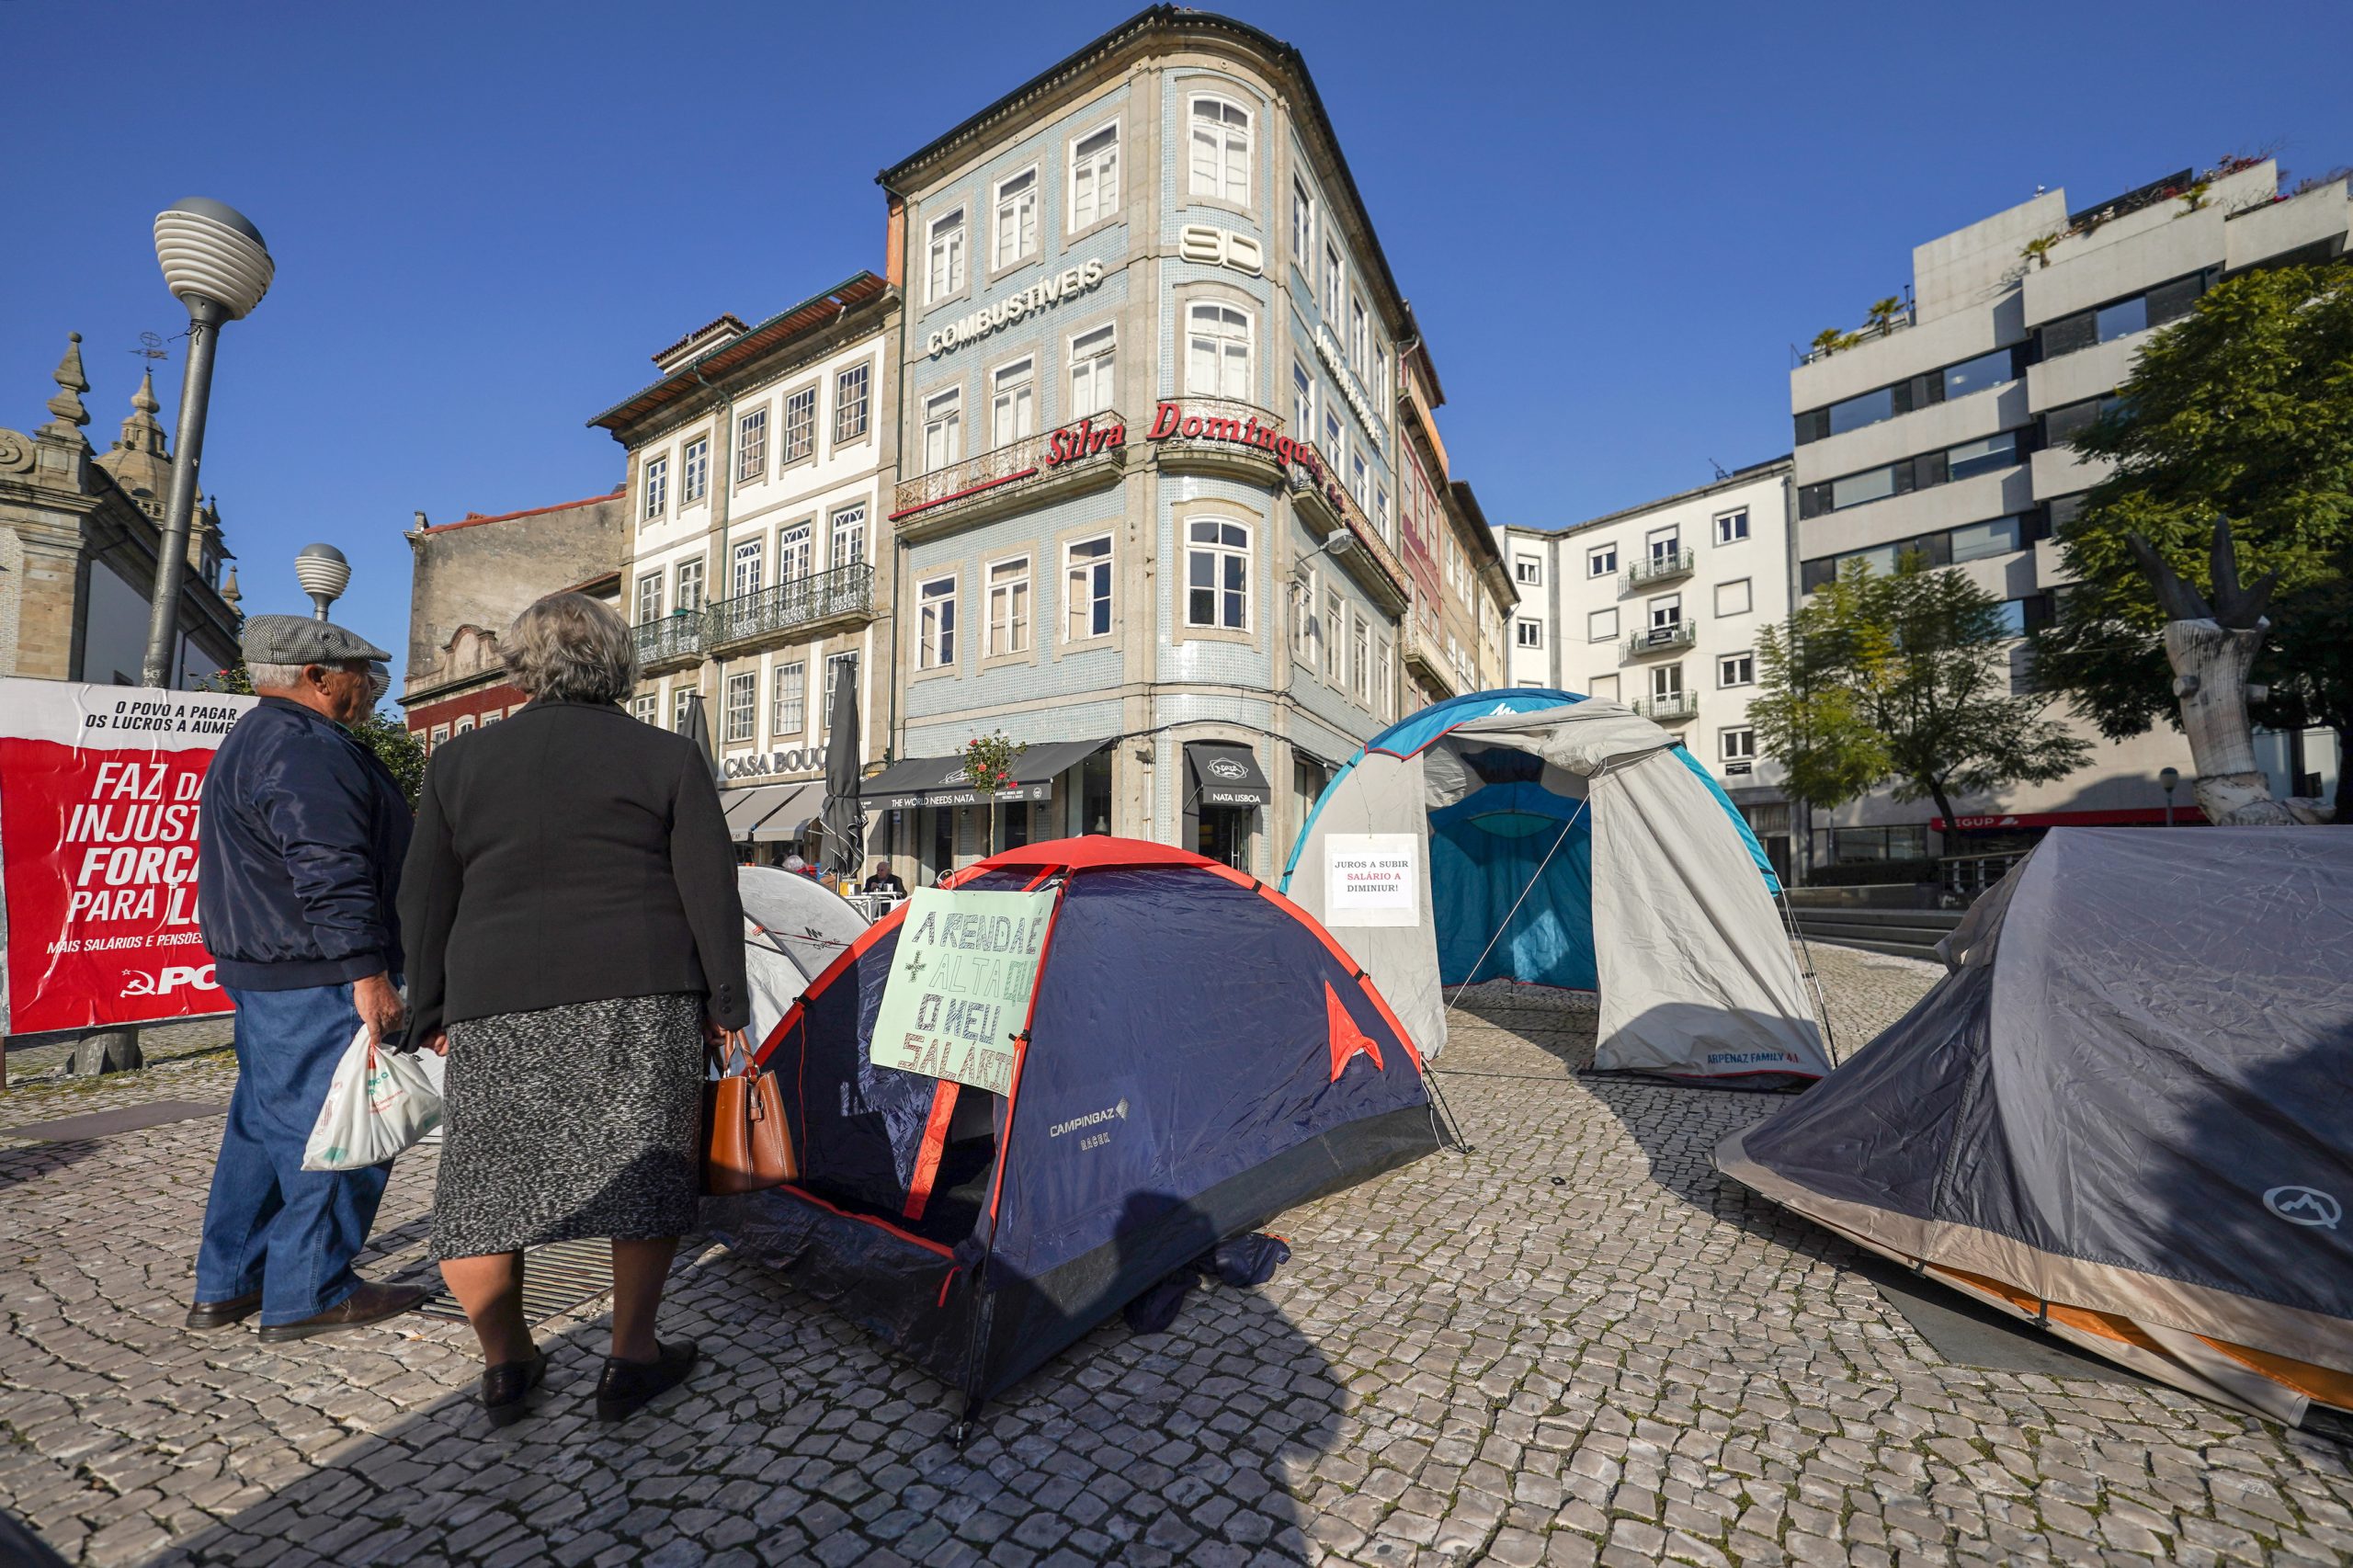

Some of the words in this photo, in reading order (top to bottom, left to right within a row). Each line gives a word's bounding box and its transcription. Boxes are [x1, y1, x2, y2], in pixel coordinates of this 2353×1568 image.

[1179, 224, 1263, 277] SD
[927, 257, 1105, 357] COMBUSTÍVEIS
[1046, 418, 1126, 467] Silva
[115, 700, 127, 714] O
[131, 702, 172, 717] POVO
[175, 705, 185, 718] A
[85, 714, 108, 728] OS
[112, 715, 173, 732] LUCROS
[176, 720, 187, 733] A
[723, 755, 771, 778] CASA
[91, 762, 168, 801] FAZ
[892, 798, 904, 808] THE
[904, 796, 928, 807] WORLD
[929, 794, 952, 805] NEEDS
[954, 793, 975, 803] NATA
[1212, 793, 1233, 802] NATA
[1235, 794, 1261, 803] LISBOA
[1335, 860, 1367, 869] JUROS
[1347, 871, 1392, 881] SALÁRIO
[67, 889, 155, 924] PARA
[47, 941, 79, 955] MAIS
[84, 936, 142, 952] SALÁRIOS
[145, 935, 153, 948] E
[912, 910, 938, 946] A
[940, 913, 1025, 955] RENDA
[928, 954, 1002, 997] ALTA
[915, 993, 944, 1031] O
[942, 998, 1002, 1045] MEU
[1707, 1053, 1749, 1064] ARPENAZ
[1751, 1052, 1784, 1063] FAMILY
[1050, 1108, 1115, 1138] CAMPINGAZ
